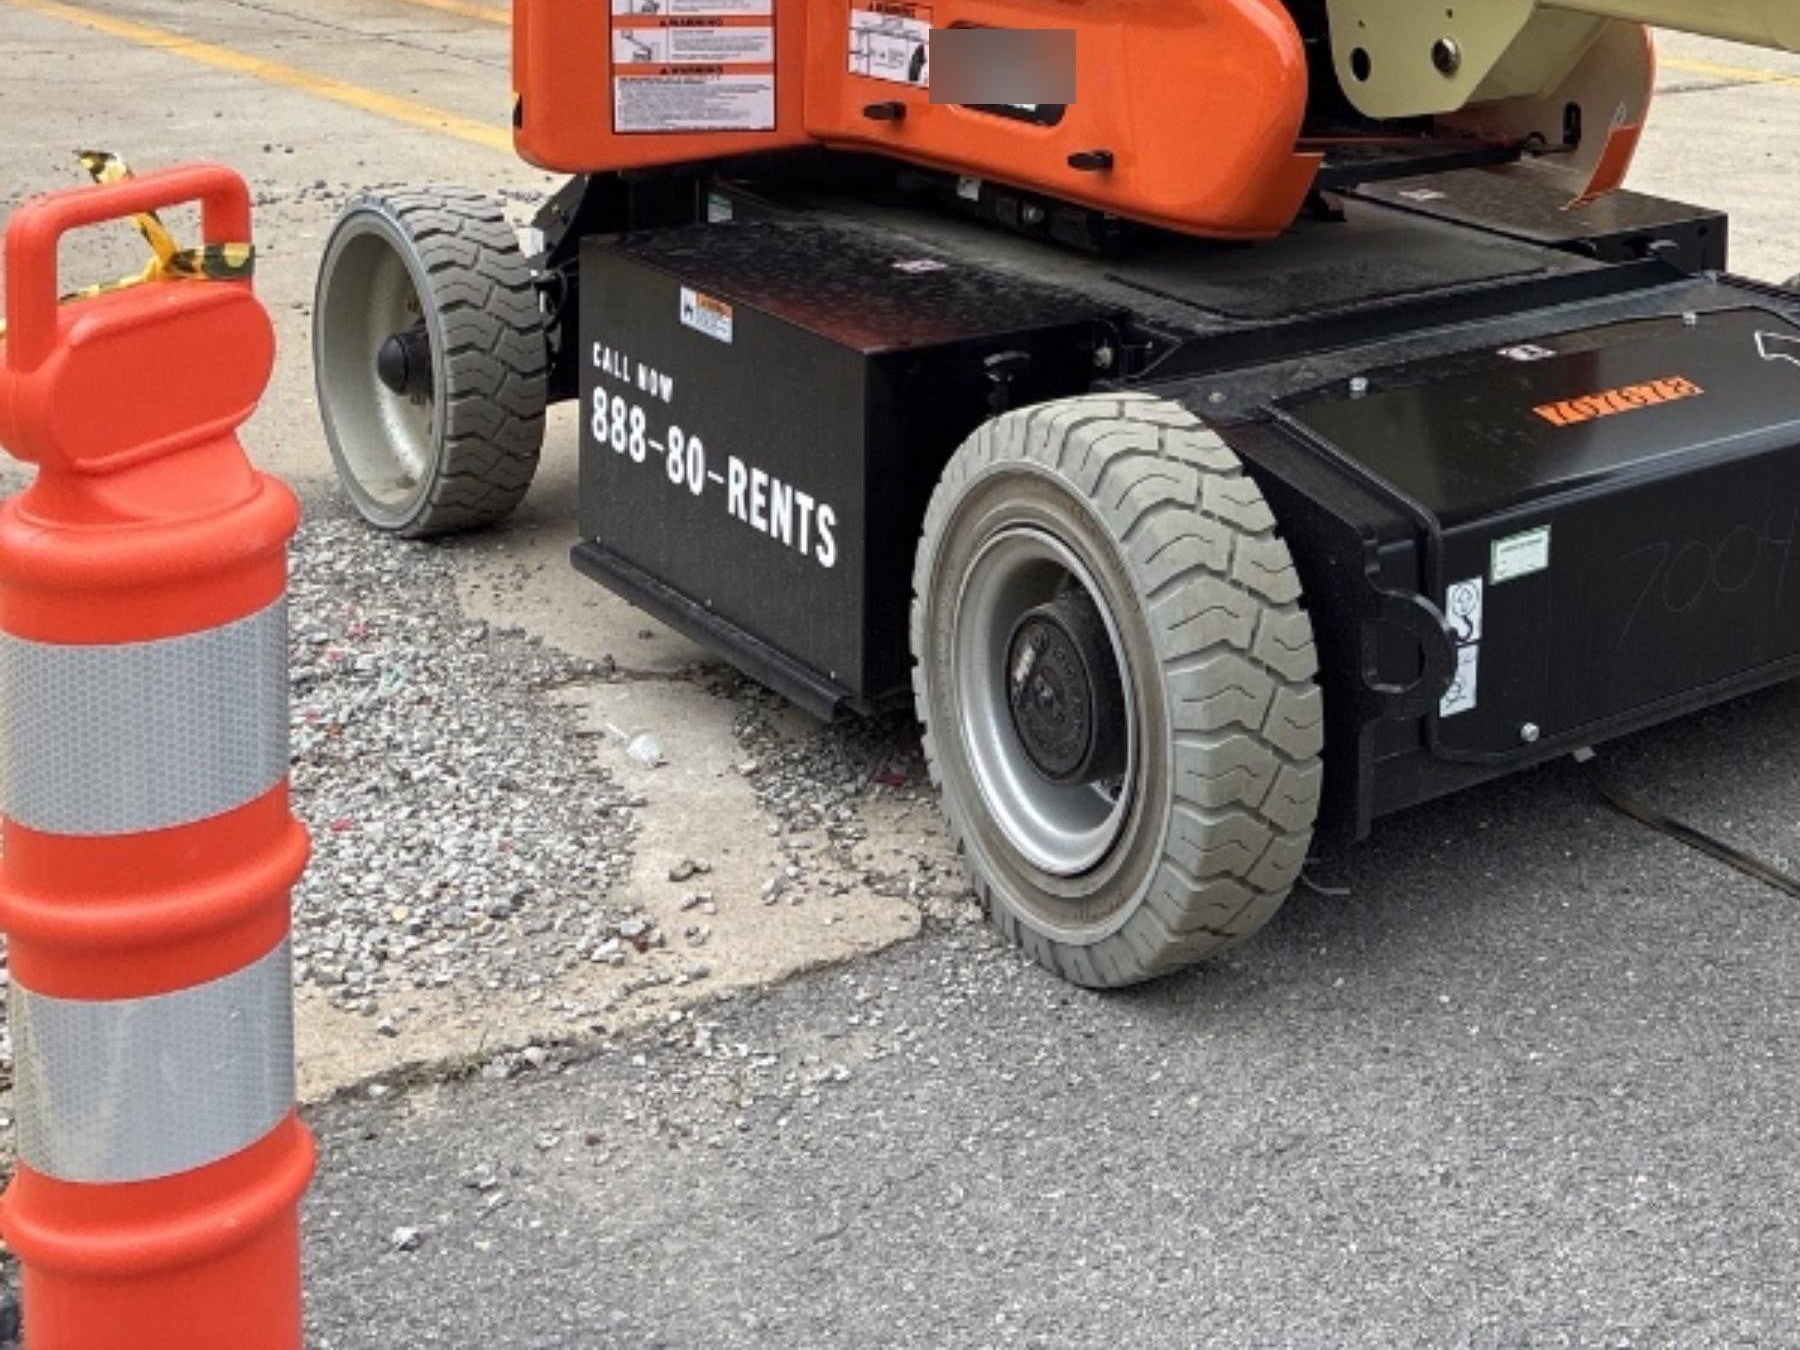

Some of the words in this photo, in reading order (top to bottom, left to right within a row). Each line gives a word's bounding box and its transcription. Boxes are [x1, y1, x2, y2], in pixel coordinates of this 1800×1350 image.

[592, 341, 632, 383] CALL
[637, 362, 674, 404] NOW
[590, 385, 839, 569] 888-80-RENTS
